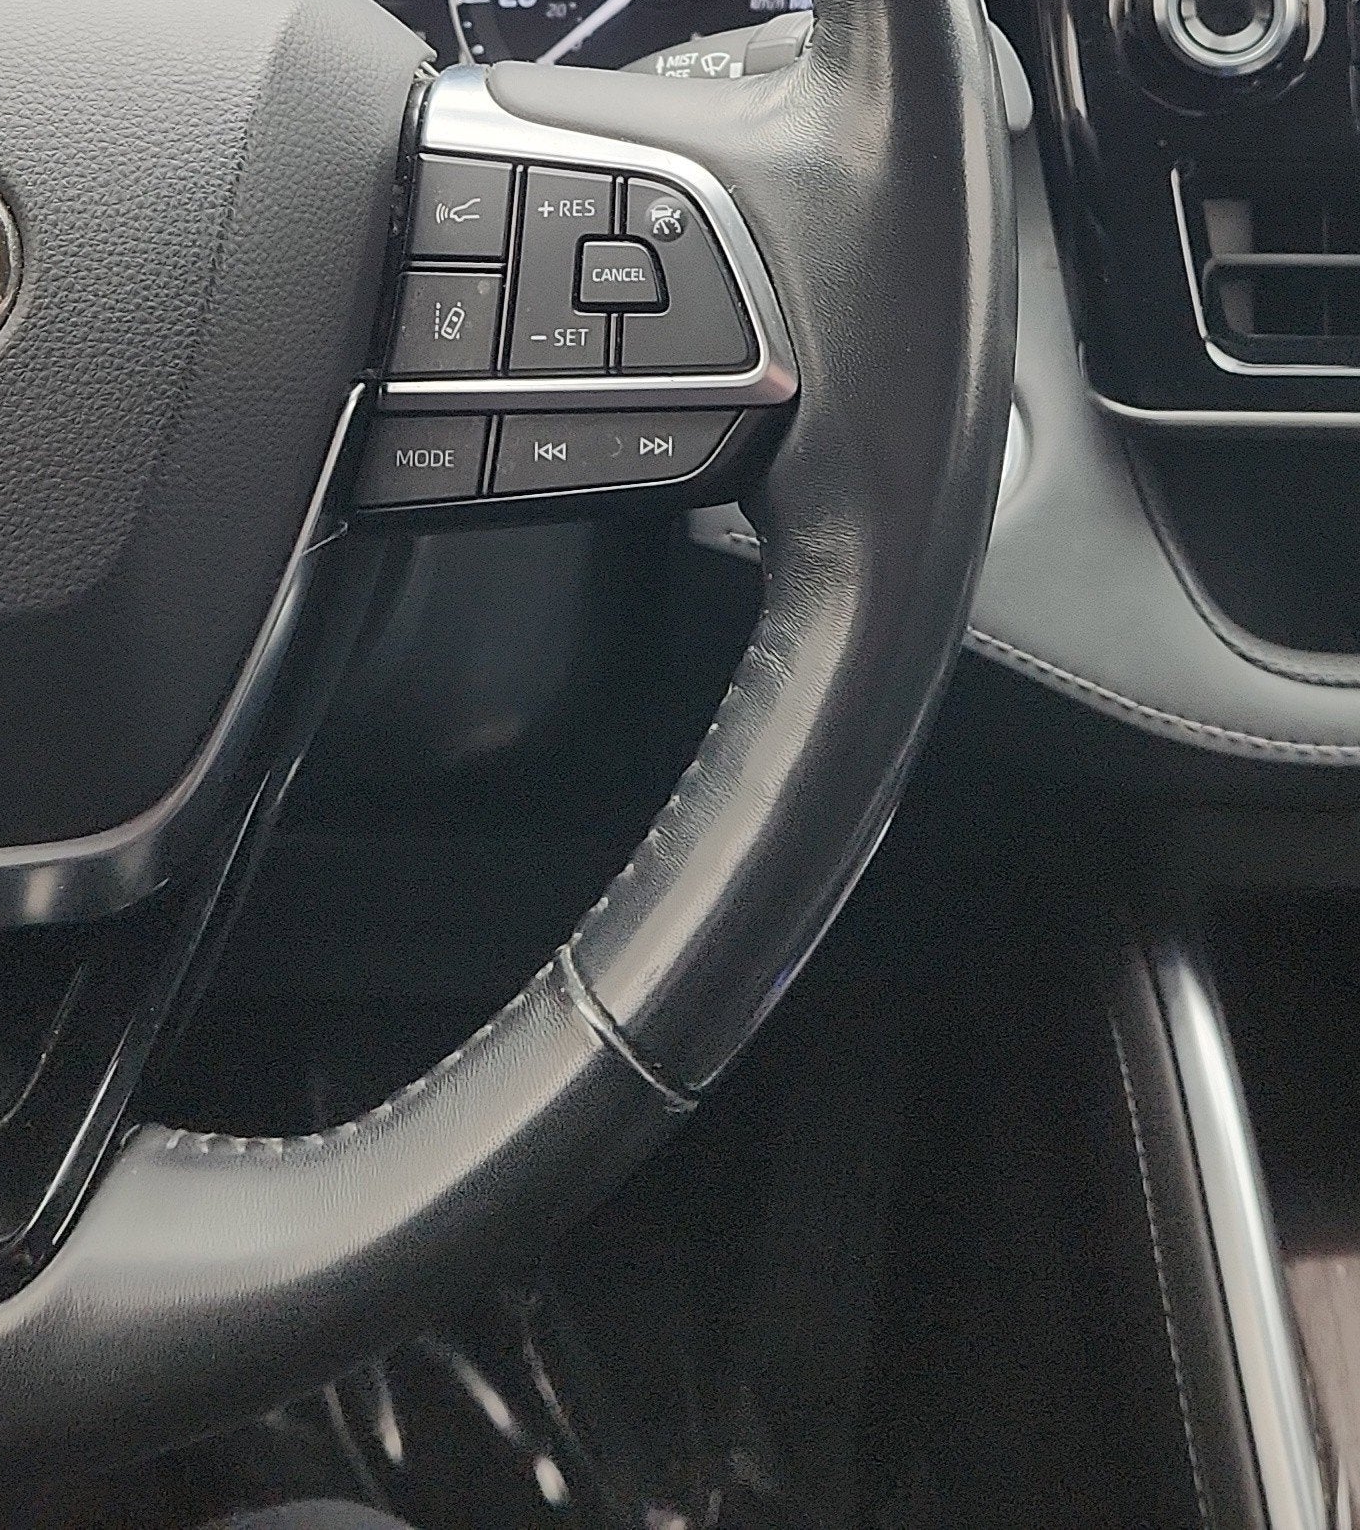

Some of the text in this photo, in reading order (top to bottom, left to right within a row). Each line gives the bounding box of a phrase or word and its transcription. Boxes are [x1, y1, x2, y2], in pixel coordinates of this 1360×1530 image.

[666, 52, 699, 68] MIST
[591, 267, 646, 283] CANCEL
[396, 449, 455, 468] MODE
